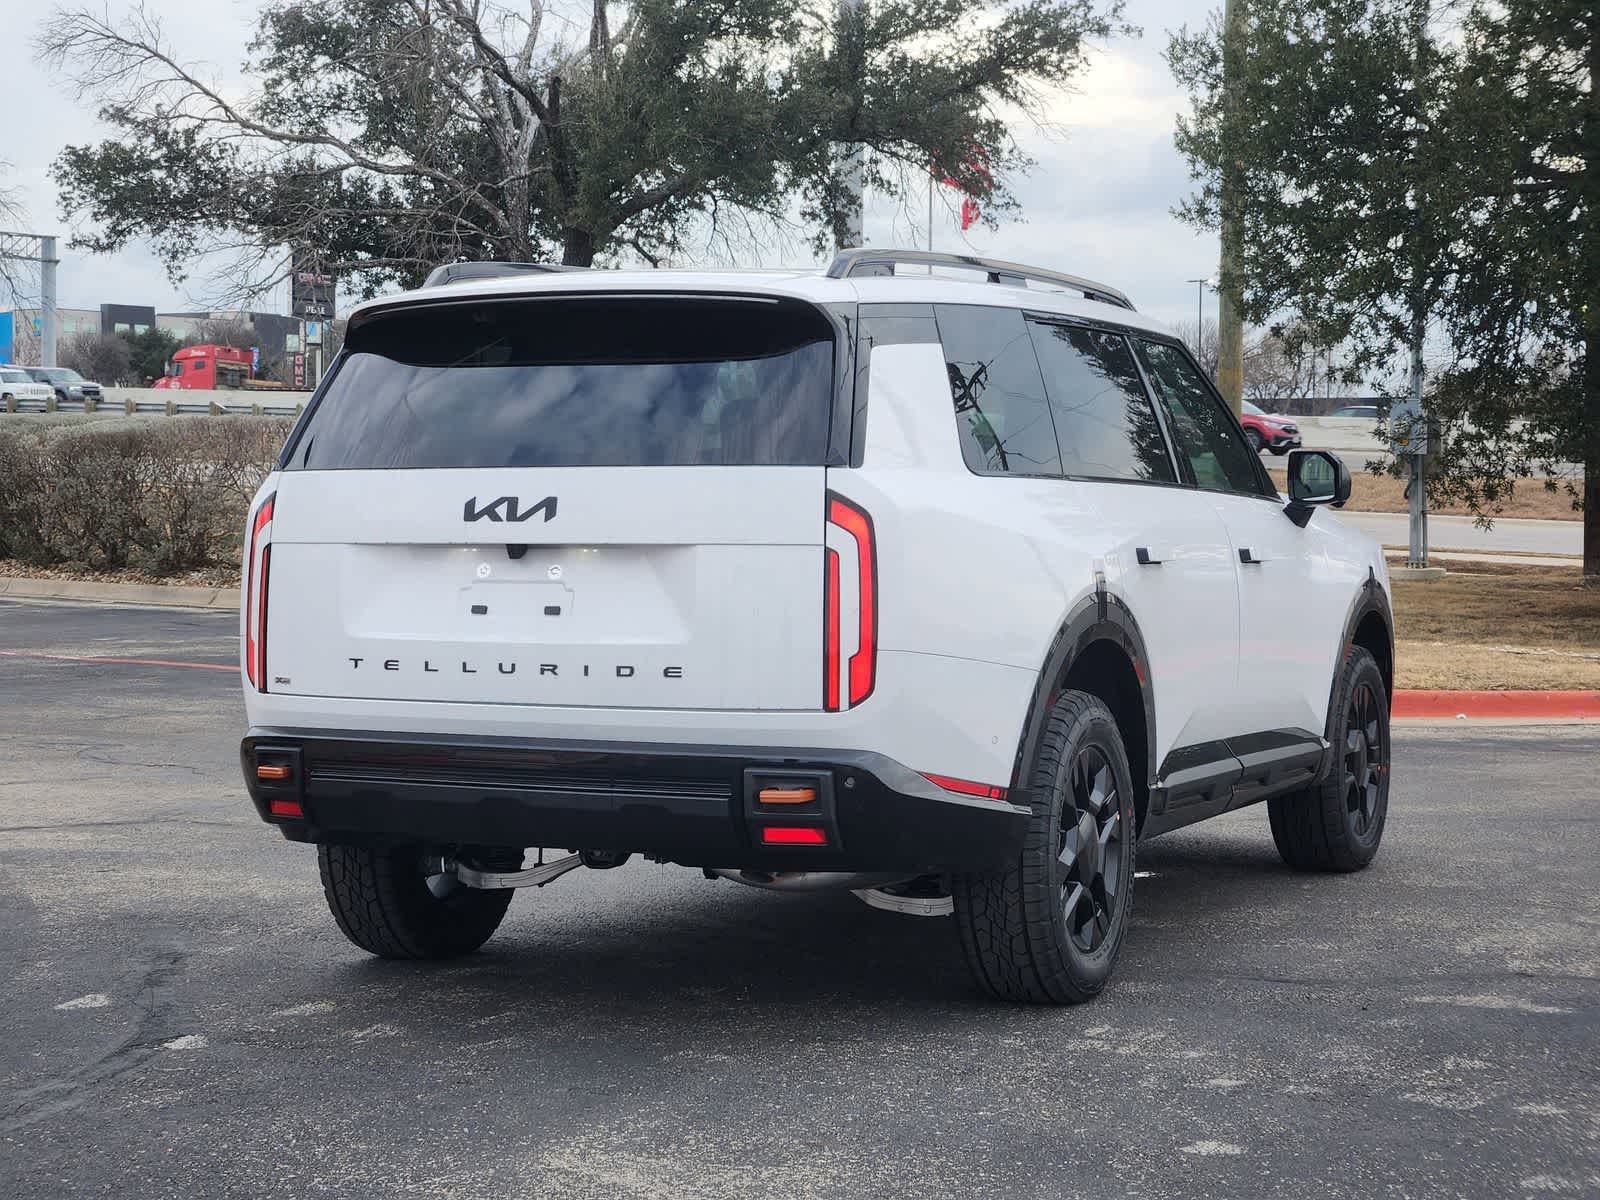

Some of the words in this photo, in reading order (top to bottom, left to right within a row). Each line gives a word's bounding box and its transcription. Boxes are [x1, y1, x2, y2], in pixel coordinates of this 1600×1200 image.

[295, 355, 304, 386] GMC
[463, 496, 558, 522] KIA
[349, 657, 683, 678] TELLURIDE
